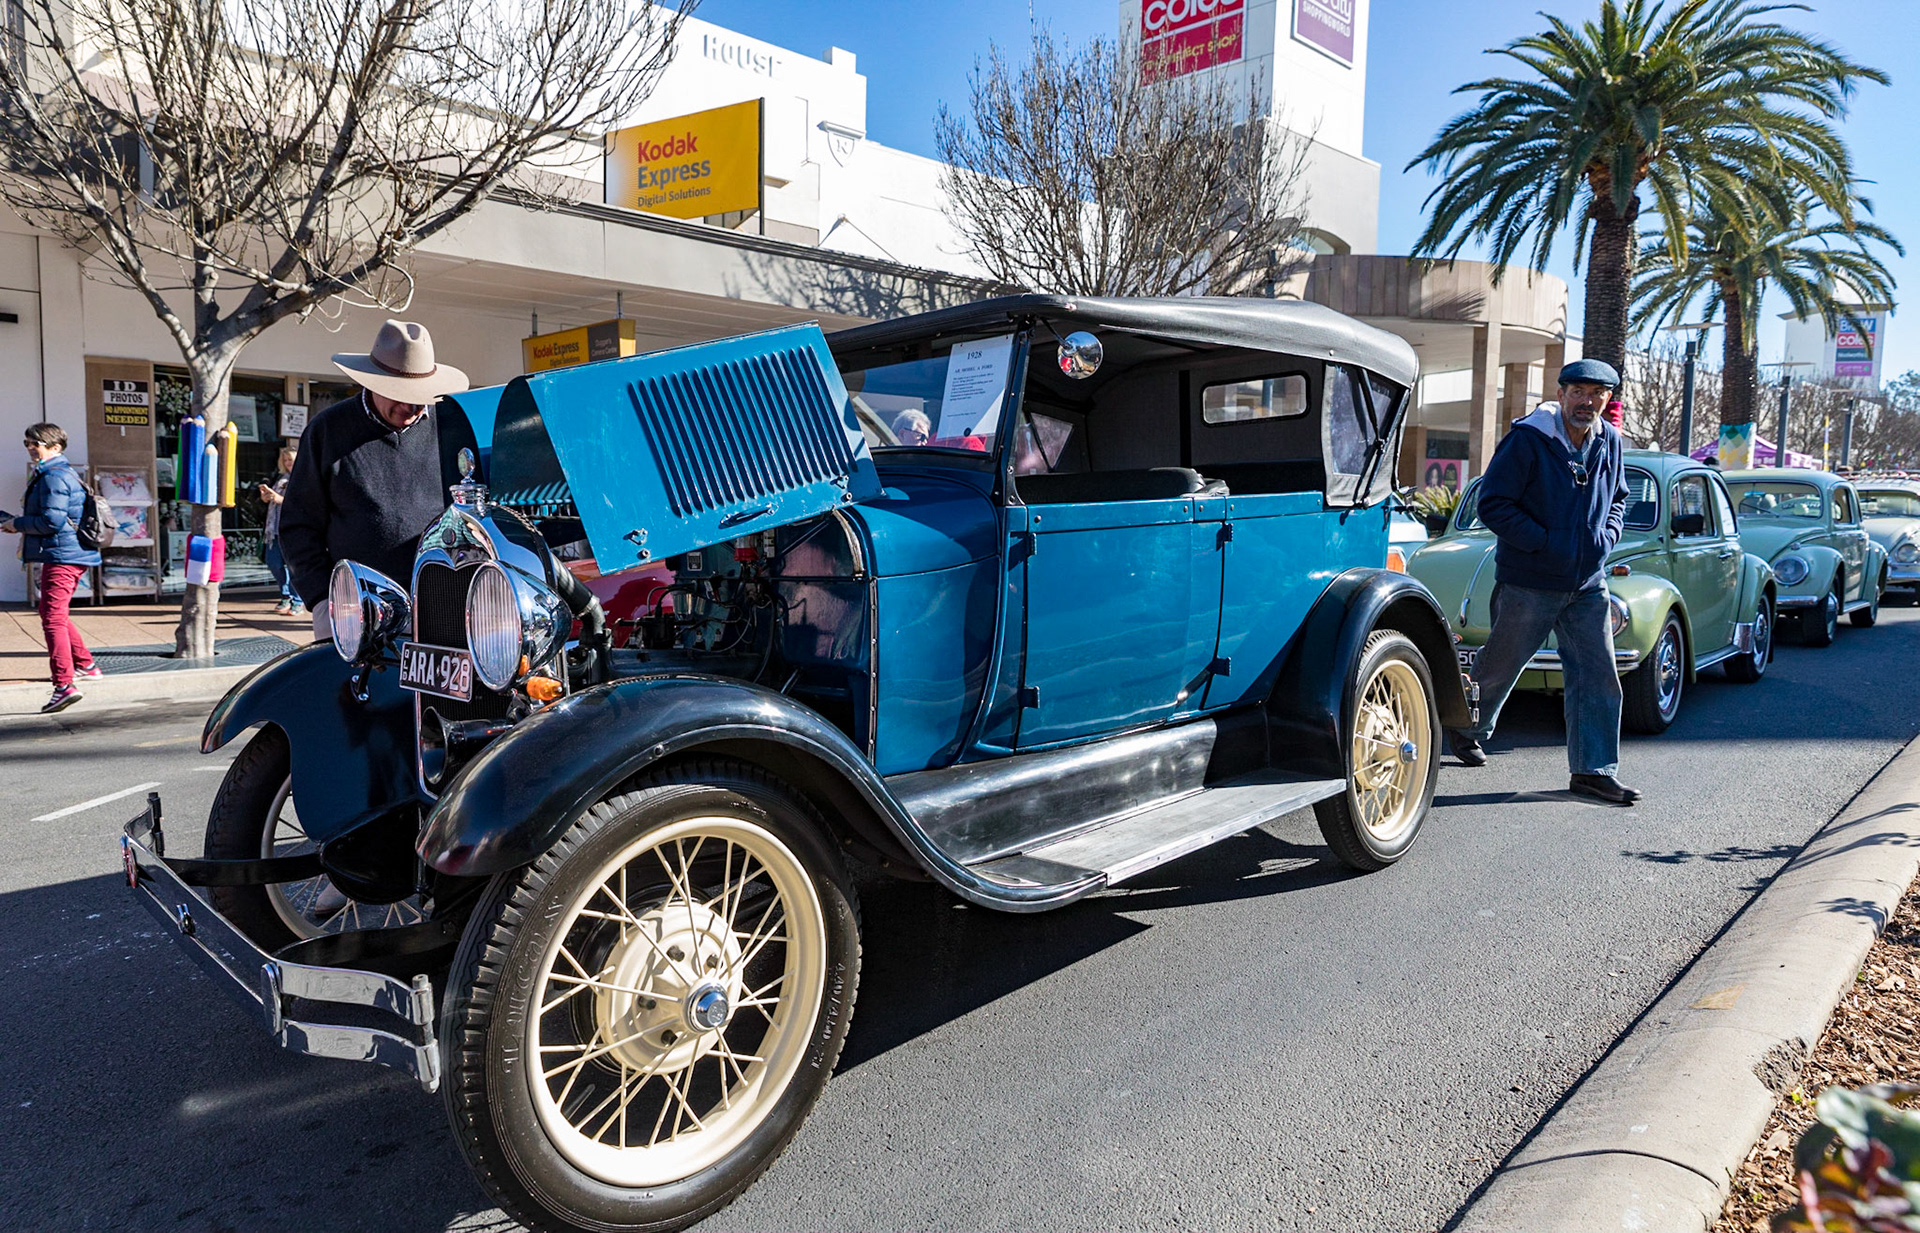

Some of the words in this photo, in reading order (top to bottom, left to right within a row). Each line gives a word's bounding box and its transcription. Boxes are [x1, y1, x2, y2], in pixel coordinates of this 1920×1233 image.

[638, 131, 698, 164] Kodak
[638, 160, 711, 190] Express
[637, 192, 667, 208] Digital
[668, 186, 711, 202] Solutions
[533, 344, 554, 359] Kodak
[553, 342, 579, 355] Express
[967, 350, 983, 360] 1928
[110, 393, 143, 403] PHOTOS
[106, 415, 148, 425] NEEDED
